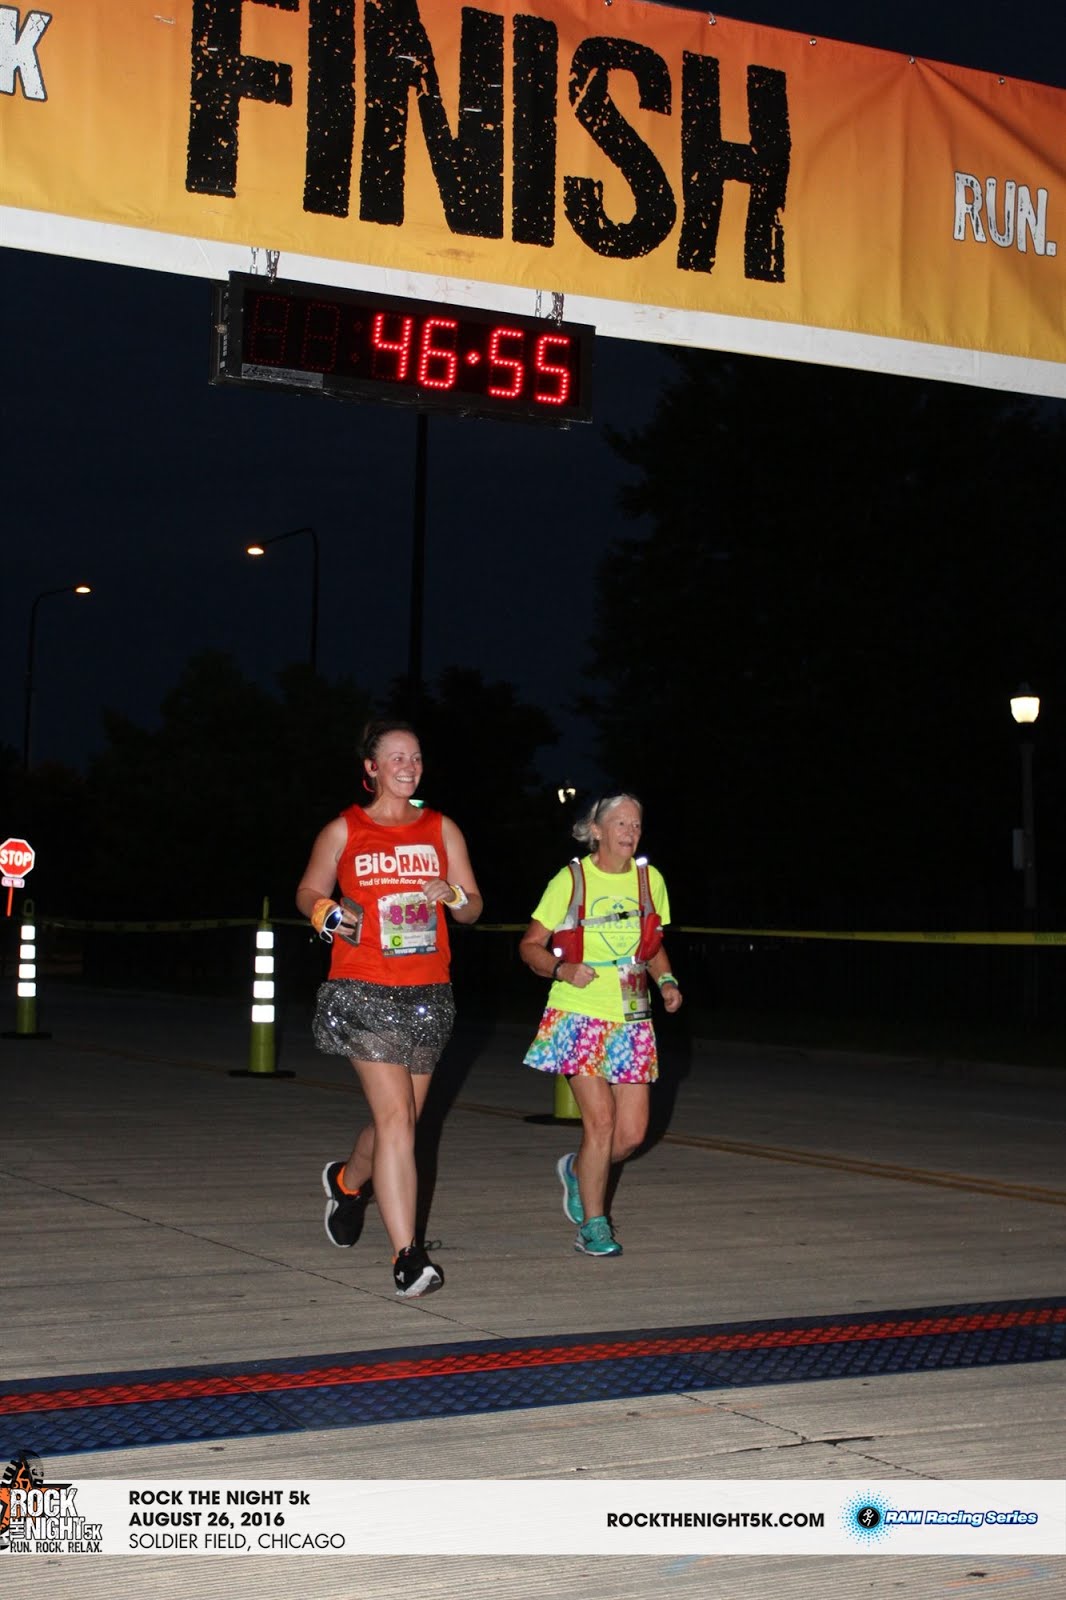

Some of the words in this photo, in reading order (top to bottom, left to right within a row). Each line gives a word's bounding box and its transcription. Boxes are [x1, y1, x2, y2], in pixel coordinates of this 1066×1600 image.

[186, 0, 792, 282] FINISH
[953, 171, 1057, 257] RUN.
[0, 849, 32, 867] STOP
[381, 877, 399, 885] Write
[400, 877, 416, 885] Race
[390, 904, 429, 925] 854
[392, 935, 402, 947] C
